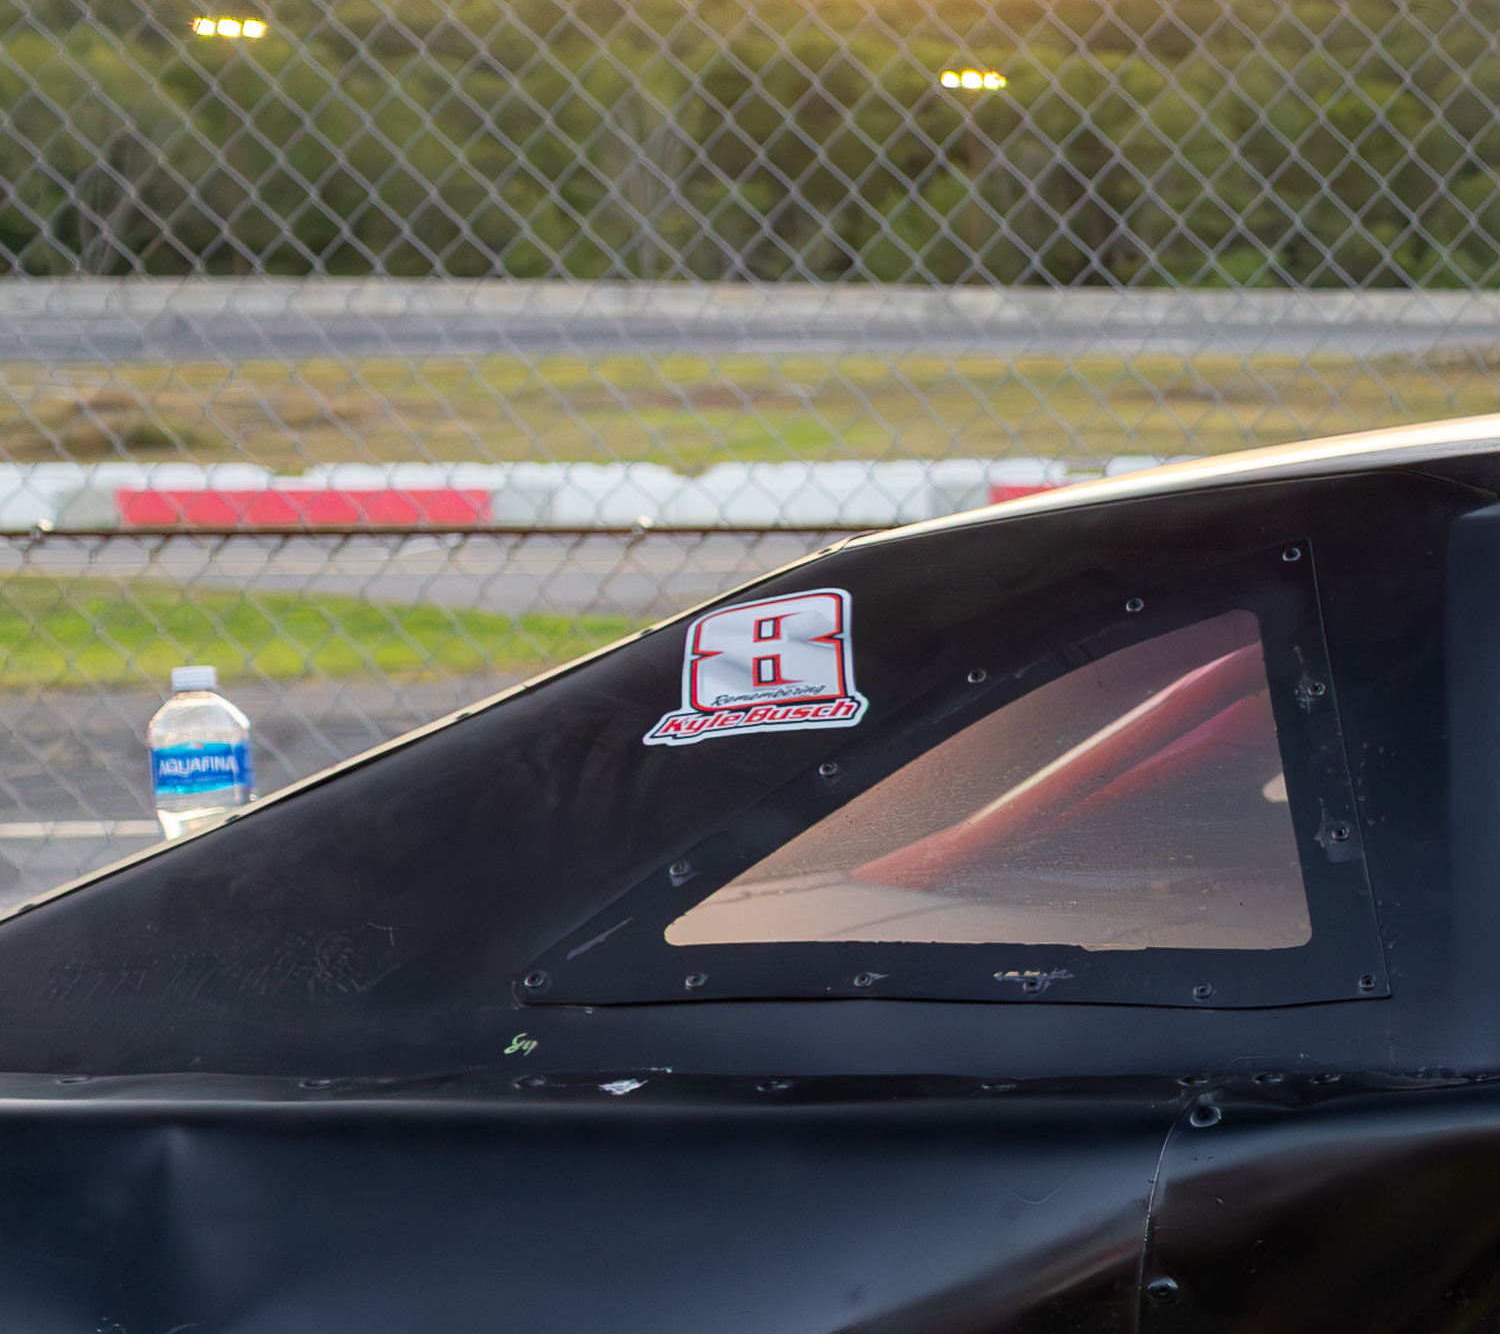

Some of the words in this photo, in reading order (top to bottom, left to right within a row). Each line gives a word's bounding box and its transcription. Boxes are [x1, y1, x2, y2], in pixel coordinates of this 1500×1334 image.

[690, 592, 847, 713] 8
[711, 683, 827, 708] Remembering
[654, 711, 744, 736] Kyle
[743, 698, 855, 725] Busch
